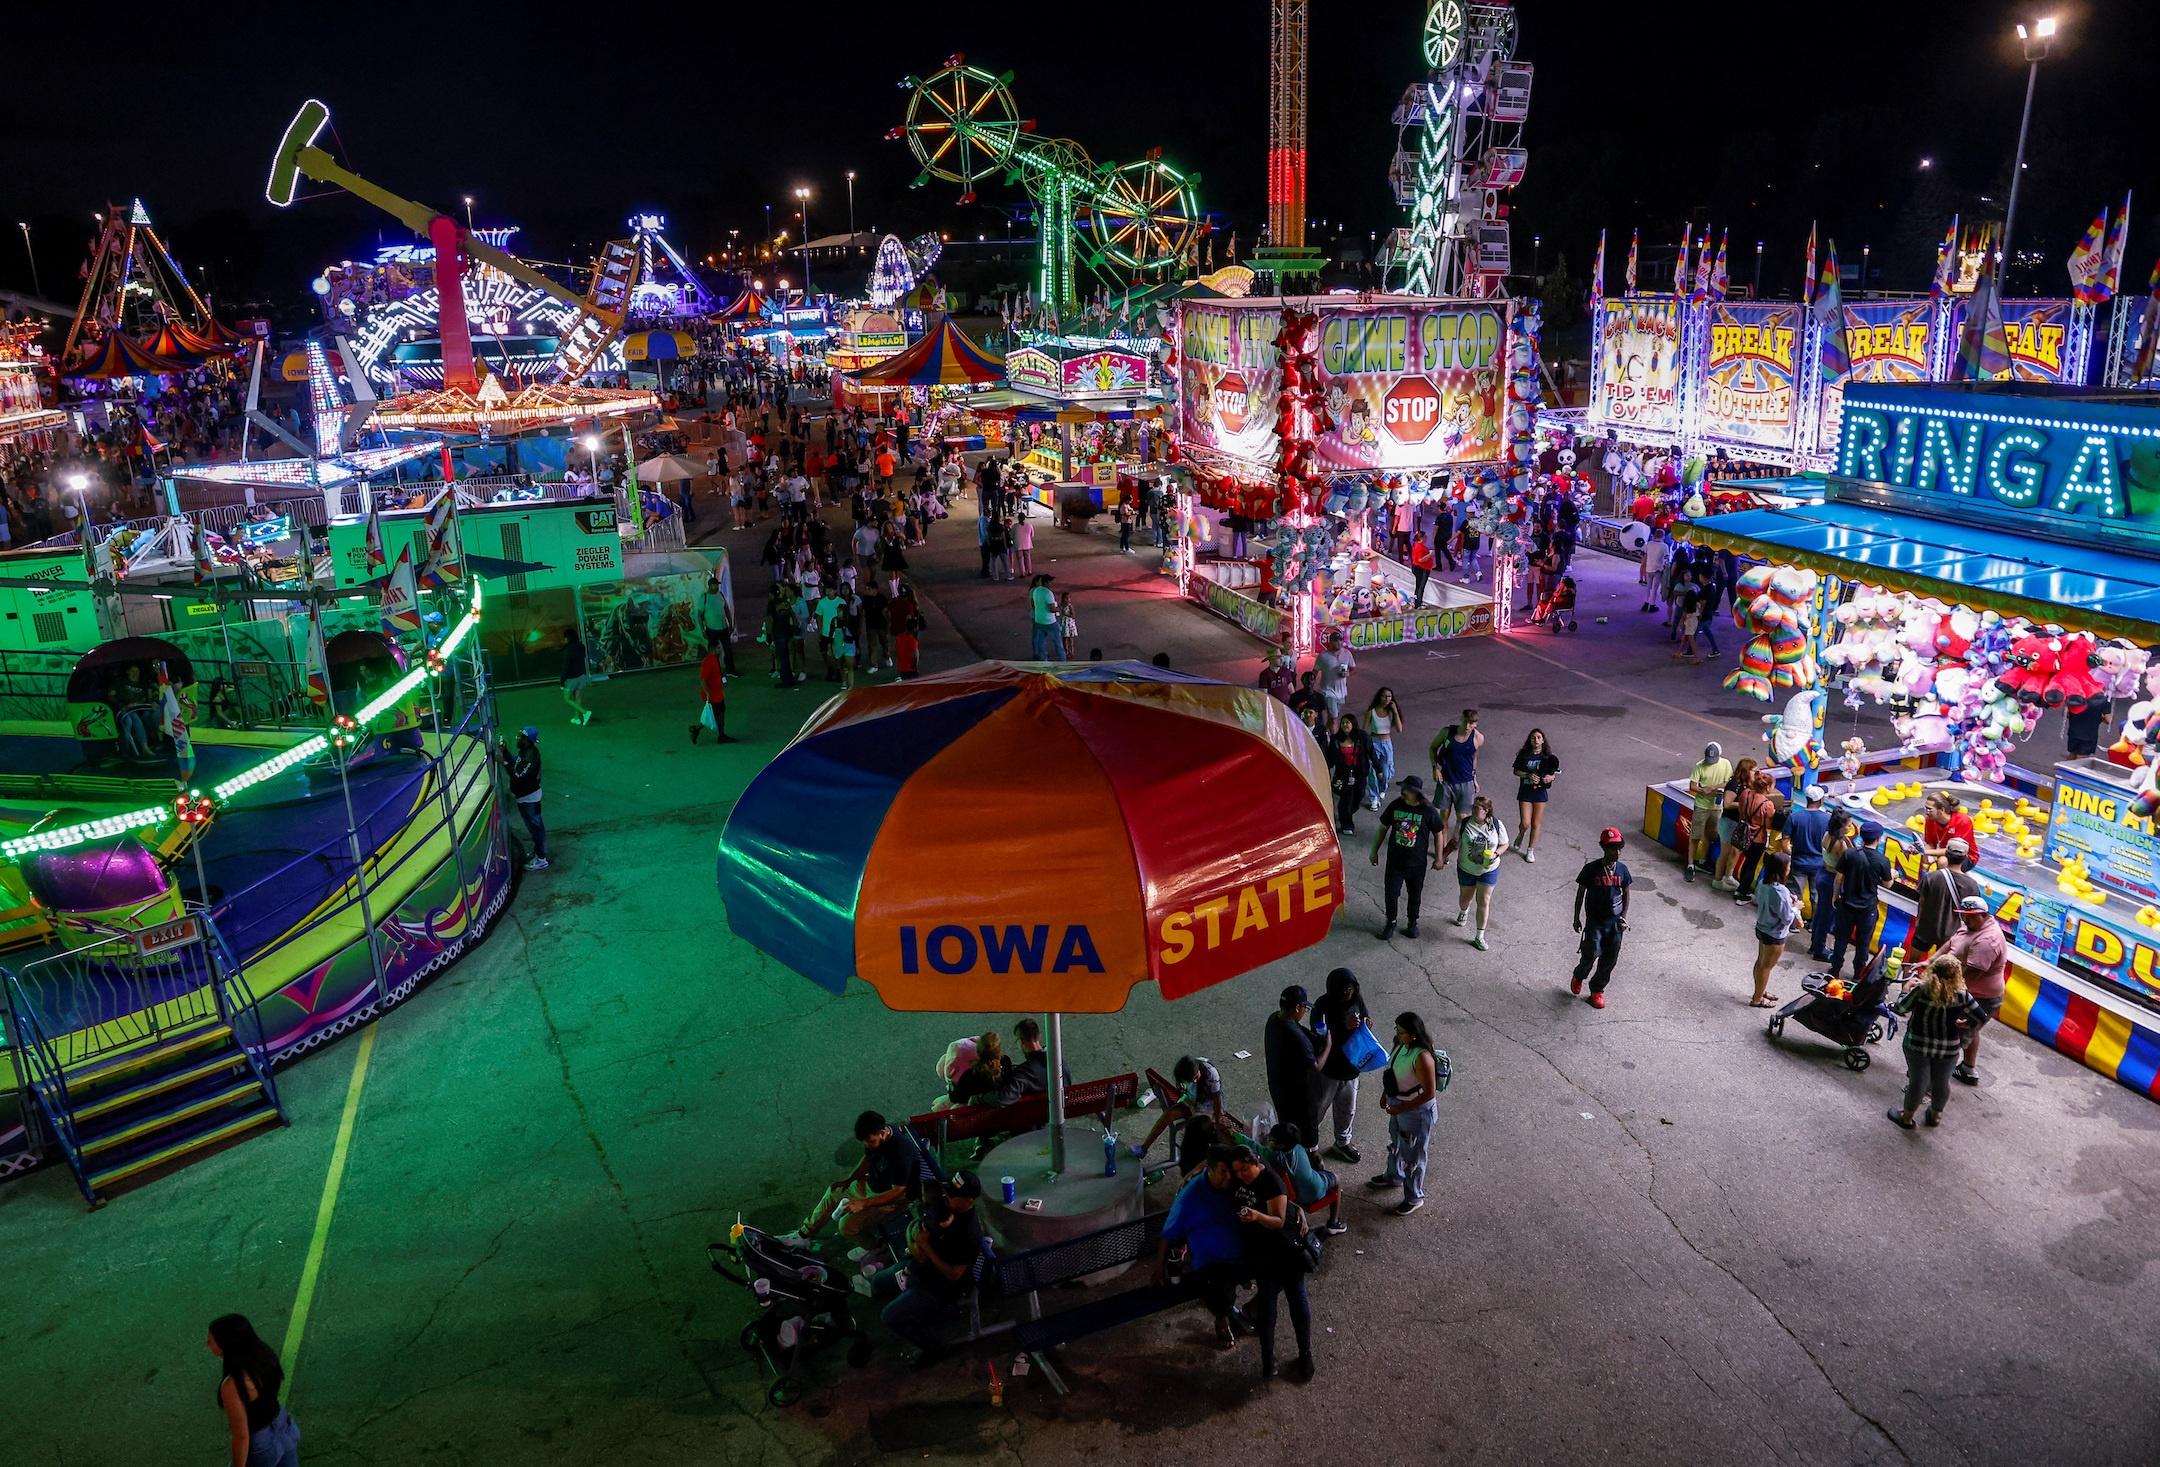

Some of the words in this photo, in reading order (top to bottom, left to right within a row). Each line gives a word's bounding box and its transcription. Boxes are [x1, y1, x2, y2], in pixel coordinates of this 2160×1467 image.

[1185, 311, 1229, 363] GAME
[1238, 313, 1281, 370] STO
[1322, 316, 1406, 374] GAME
[1424, 312, 1499, 370] STOP
[1711, 324, 1794, 373] BREAK
[1741, 359, 1757, 388] A
[1215, 389, 1246, 416] STOP
[1606, 383, 1633, 399] TIP
[1641, 386, 1672, 403] 'EM
[1708, 381, 1792, 422] BOTTLE
[1386, 396, 1438, 424] STOP
[589, 511, 614, 528] CAT
[576, 546, 610, 556] ZIEGLER
[578, 553, 609, 563] POWER
[575, 561, 615, 571] SYSTEMS
[1351, 619, 1404, 648] GAME
[1415, 611, 1466, 640] STOP
[1470, 613, 1490, 625] STOP
[2058, 784, 2116, 821] RING
[1160, 859, 1334, 965] STATE
[151, 925, 184, 945] EXIT
[900, 924, 1105, 974] IOWA
